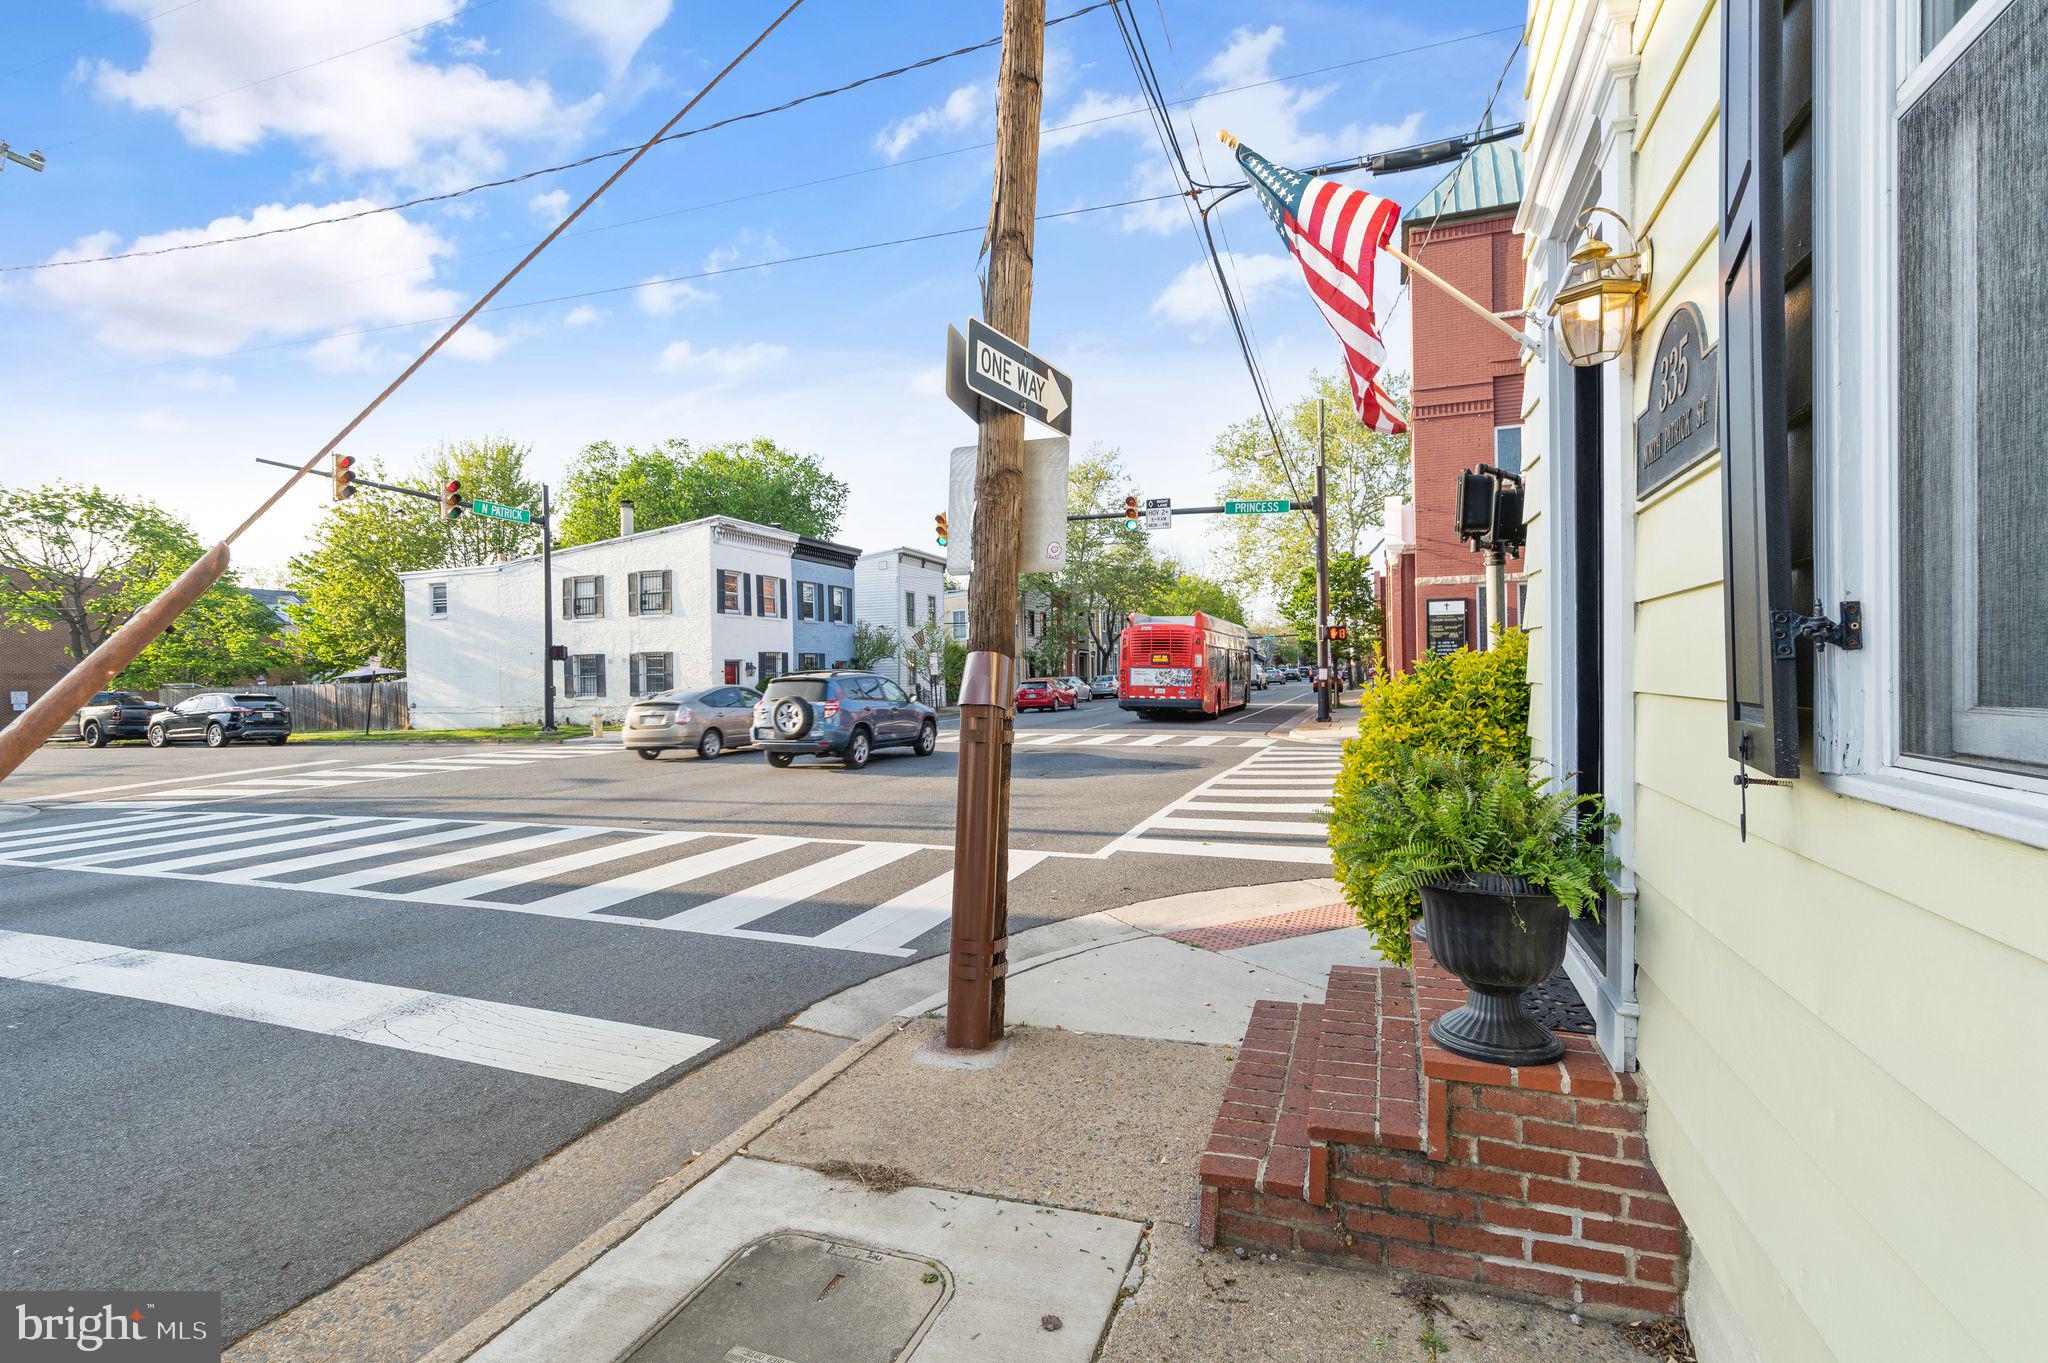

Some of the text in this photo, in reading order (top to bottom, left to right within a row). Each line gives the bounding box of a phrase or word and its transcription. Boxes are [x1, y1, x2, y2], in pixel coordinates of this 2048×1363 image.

[981, 347, 1045, 402] ONE WAY
[1659, 333, 1689, 413] 335
[1664, 407, 1692, 454] PATRICK
[481, 502, 523, 520] N PATRICK
[1235, 501, 1279, 513] PRINCESS
